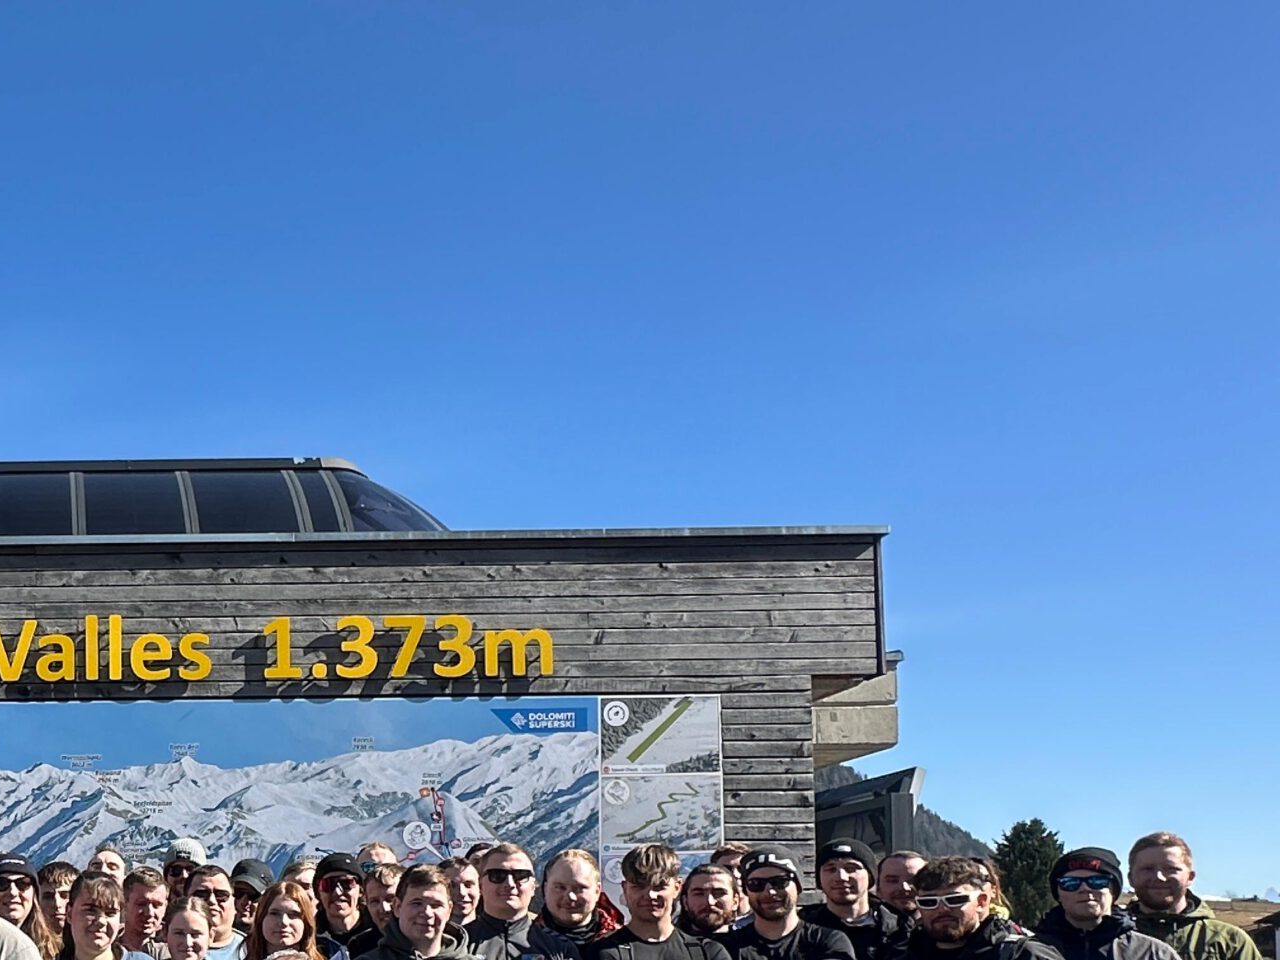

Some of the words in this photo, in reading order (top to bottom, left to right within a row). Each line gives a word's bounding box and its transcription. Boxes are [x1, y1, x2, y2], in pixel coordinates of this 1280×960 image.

[262, 614, 554, 679] 1.373m
[528, 712, 576, 721] DOLOMITI
[528, 720, 576, 729] SUPERSKI
